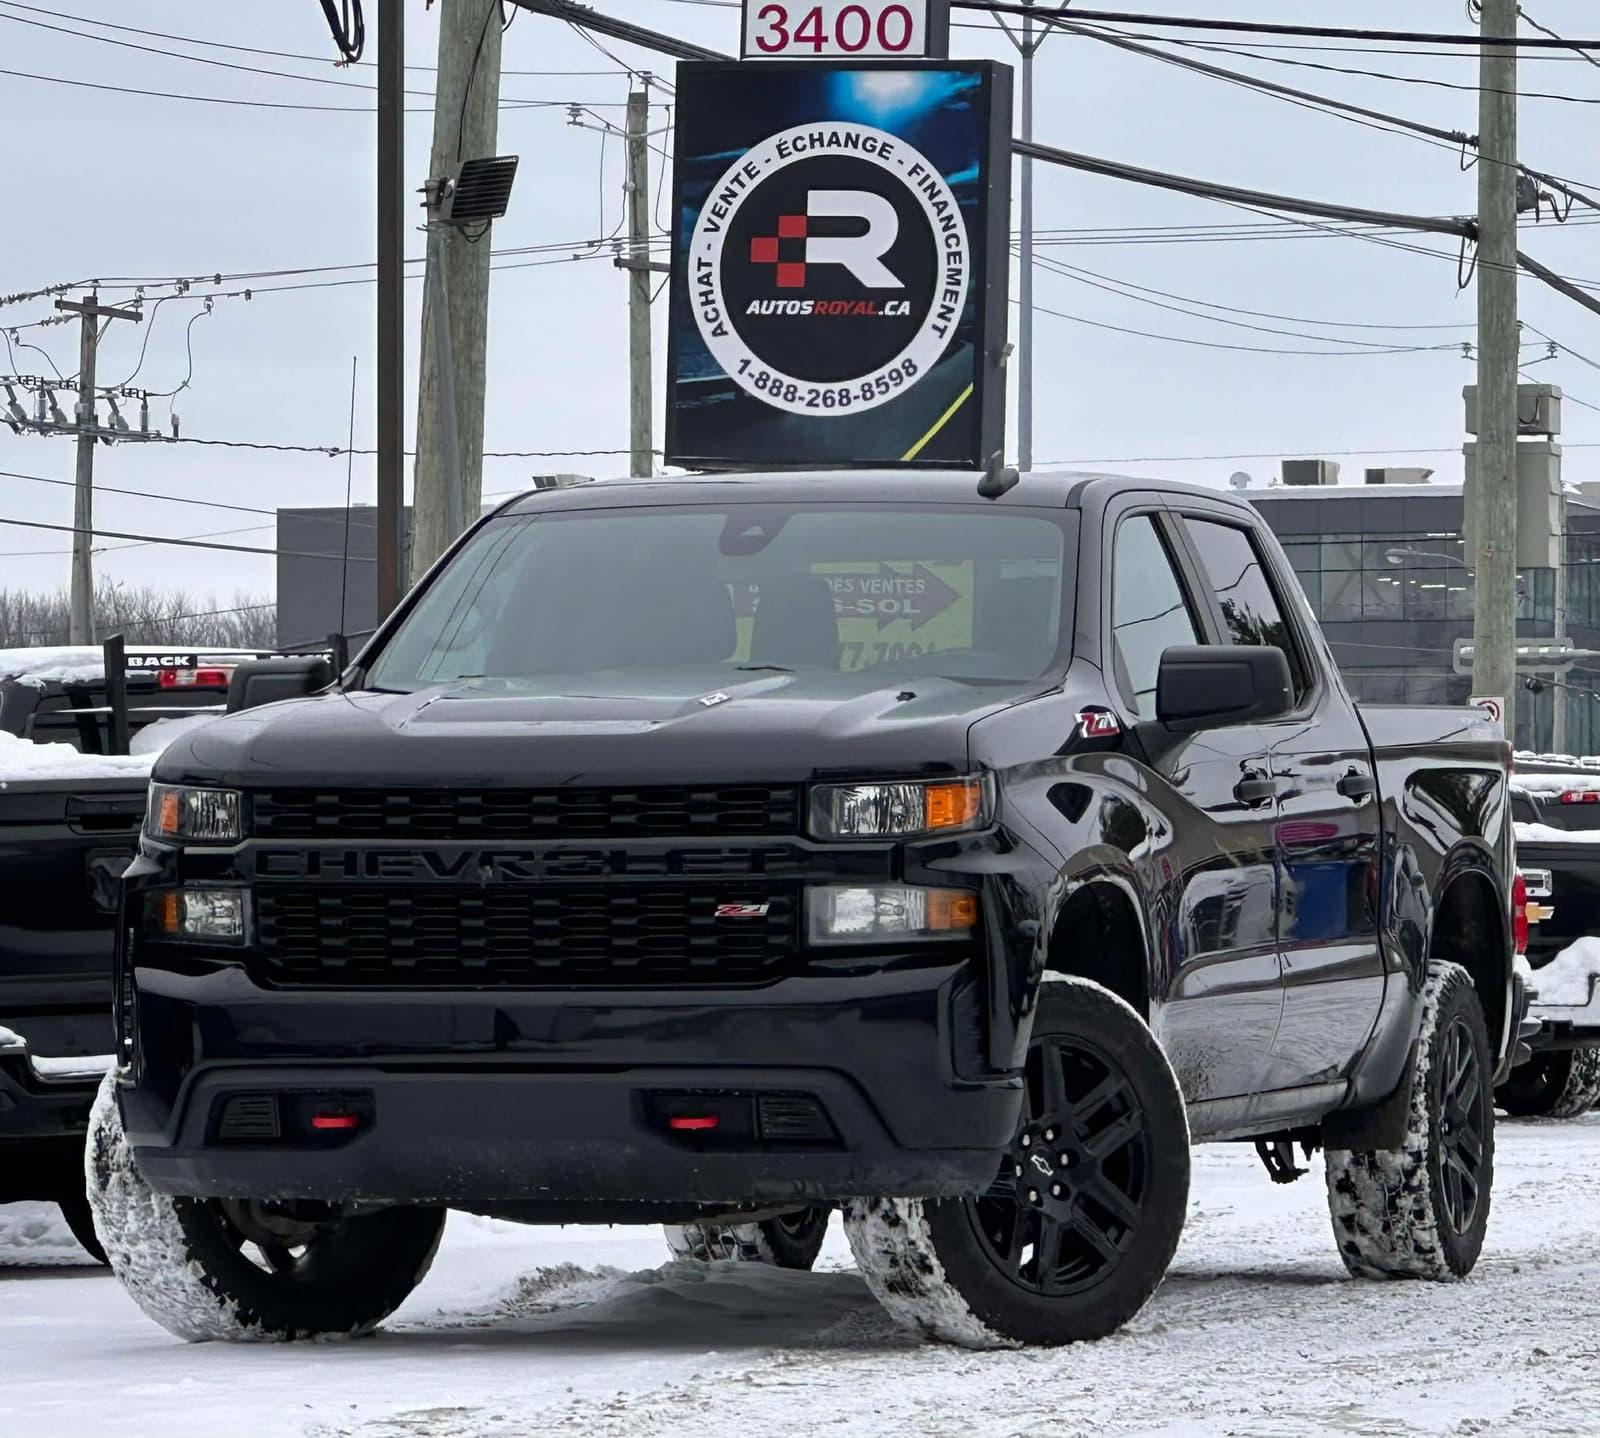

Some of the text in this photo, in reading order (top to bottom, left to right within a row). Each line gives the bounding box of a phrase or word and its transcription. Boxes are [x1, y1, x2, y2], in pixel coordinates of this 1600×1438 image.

[755, 4, 913, 53] 3400
[775, 131, 894, 161] ÉCHANGE
[703, 160, 761, 234] VENTE
[907, 163, 963, 339] FINANCEMENT
[697, 257, 729, 338] ACHAT
[746, 300, 910, 316] AUTOSROYAL.CA
[737, 358, 918, 408] 1-888-268-8598
[860, 578, 926, 594] VENTES
[127, 656, 190, 667] BACK
[255, 847, 790, 879] CHEVROLET
